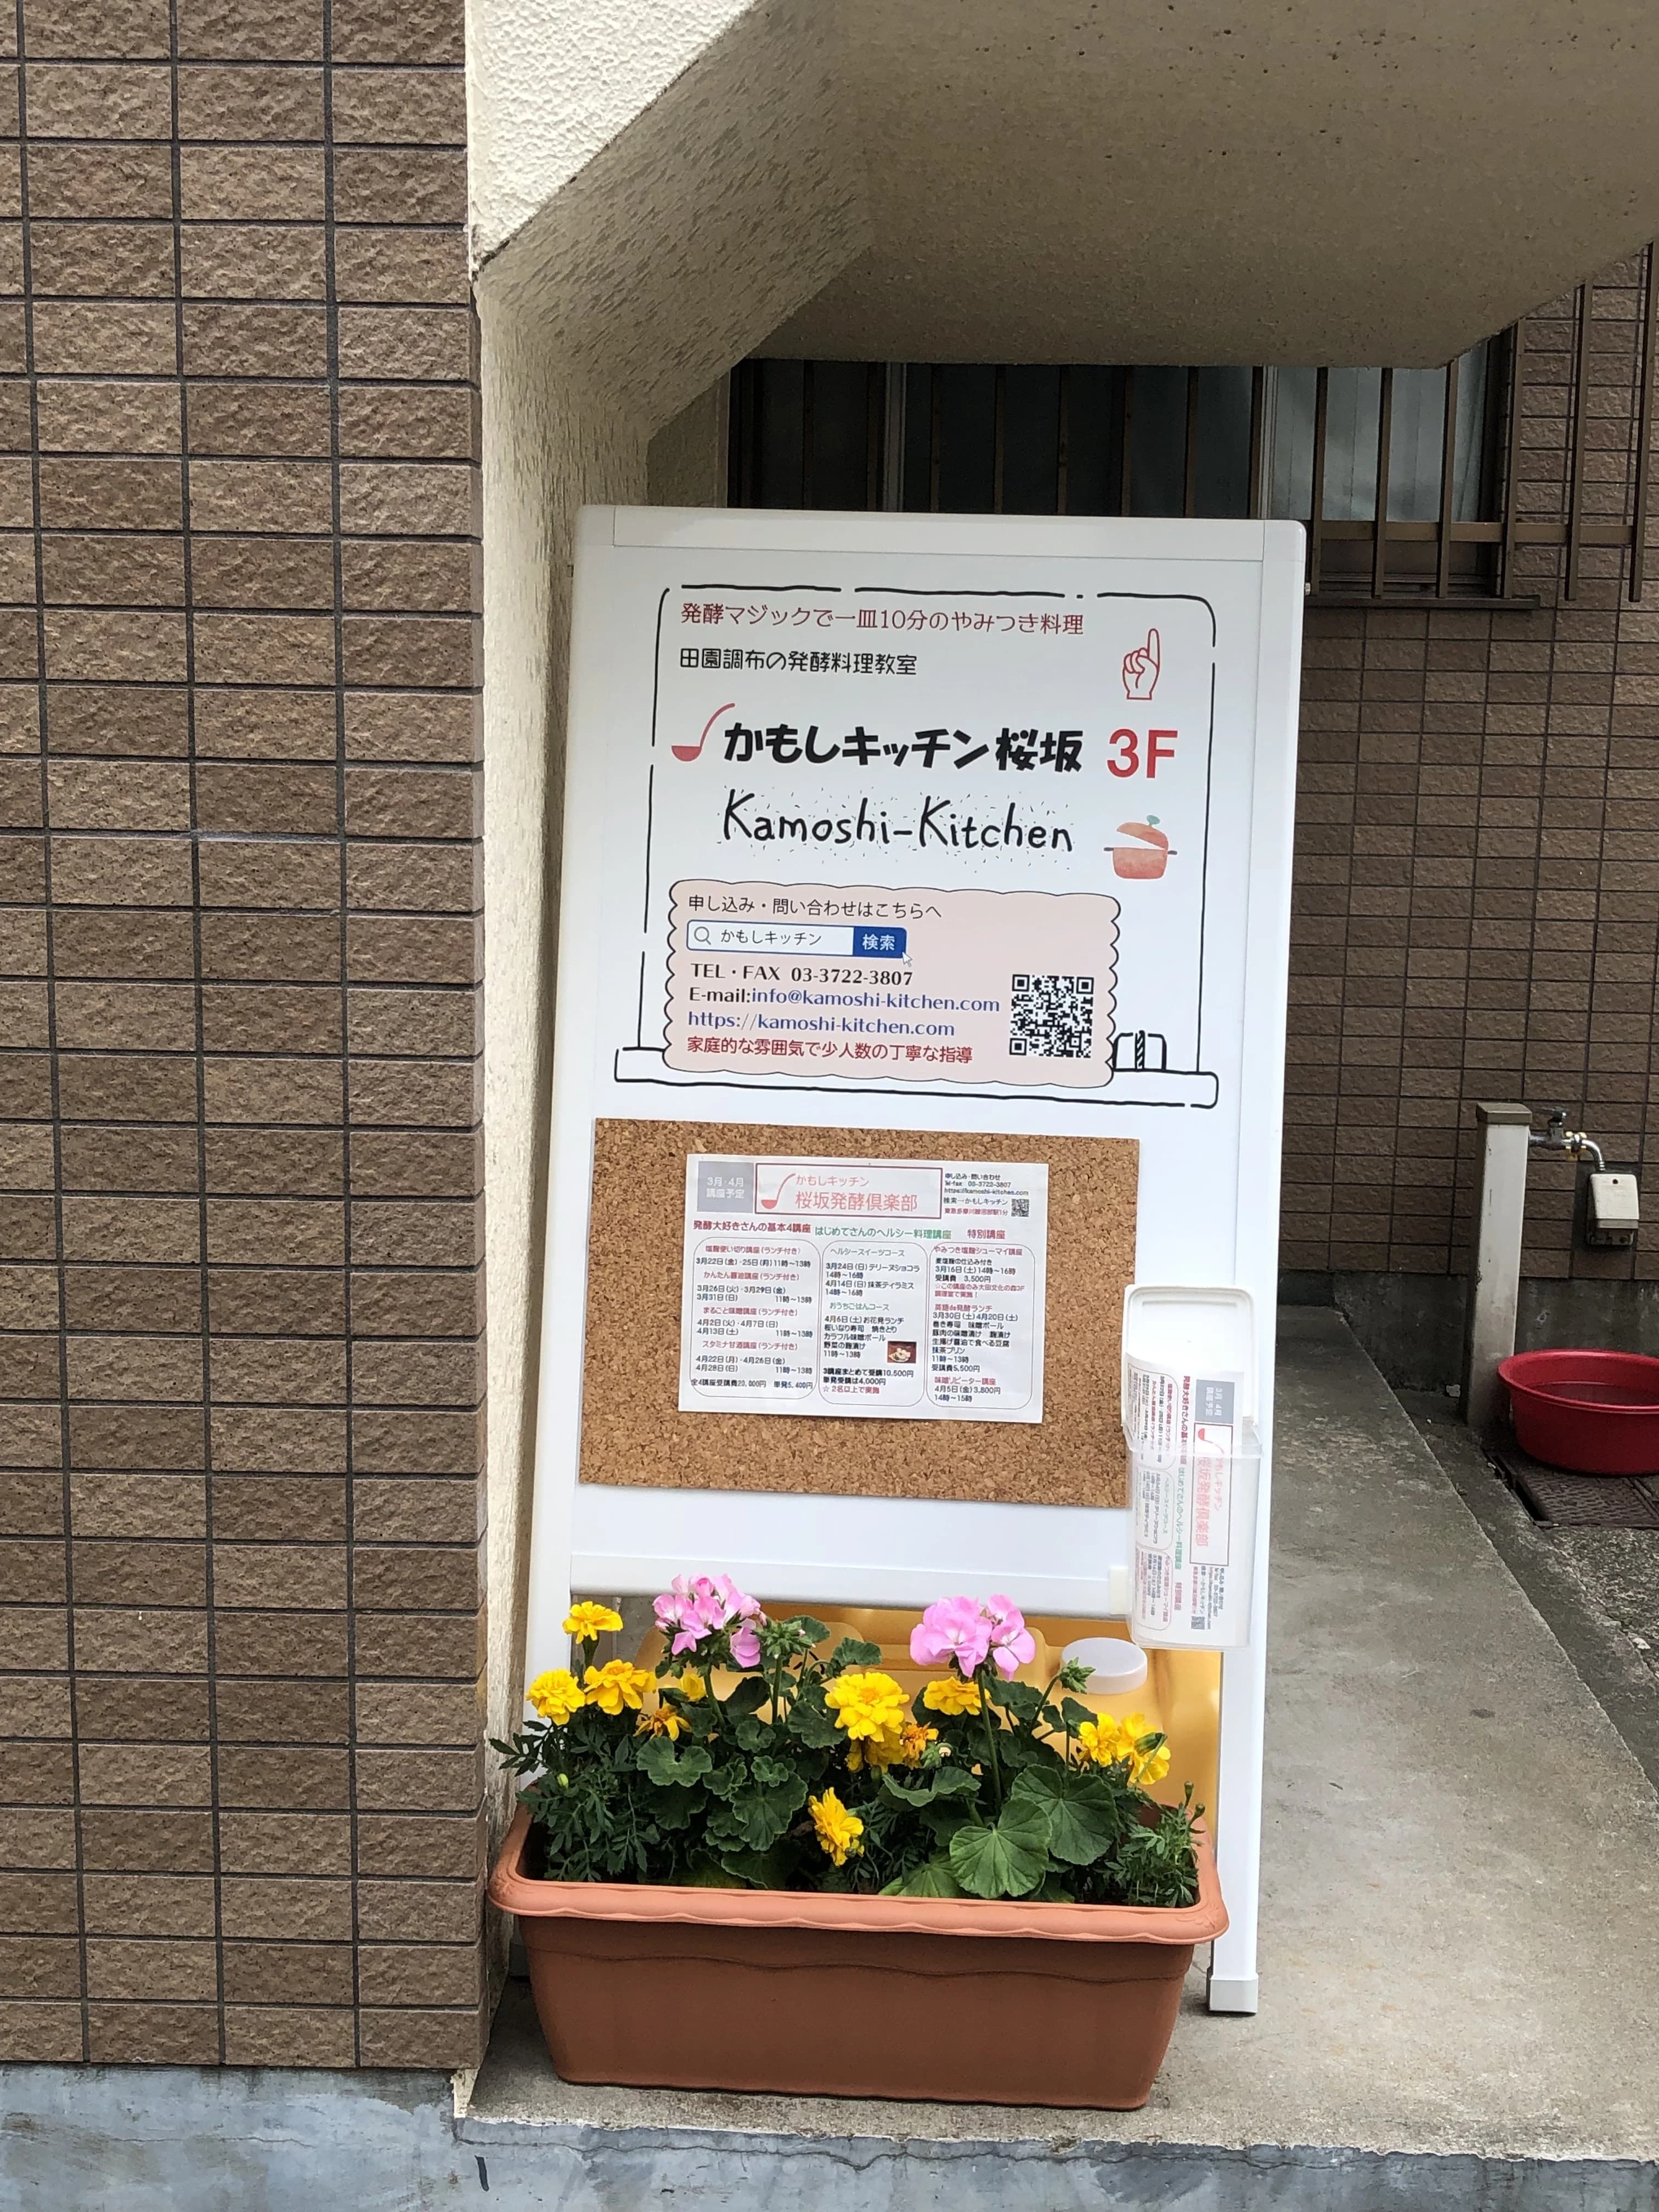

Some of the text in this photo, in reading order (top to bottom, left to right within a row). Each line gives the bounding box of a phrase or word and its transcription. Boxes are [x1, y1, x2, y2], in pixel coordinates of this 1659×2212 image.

[680, 602, 1084, 636] 発酵マジックで一皿10分のやみつき料理
[679, 647, 917, 676] 田園調布の発酵料理教室
[723, 721, 1178, 778] かもしキッチン桜坂 3F
[723, 790, 1073, 852] Kamoshi-Kitchen
[689, 895, 943, 919] 申し込み・問い合わせはこちらへ
[720, 929, 822, 947] かもしキッチン
[862, 933, 896, 952] 検索
[791, 967, 913, 986] 03-3722-3807
[690, 986, 1000, 1013] E-mail:info@kamoshi-kitchen.com
[687, 1011, 956, 1037] https://kamoshi-kitchen.com
[687, 1036, 973, 1064] 家庭的な雰囲気で少人数の丁寧な指導
[795, 1175, 870, 1187] かもしキッチン
[706, 1188, 744, 1199] 講座予定
[795, 1190, 918, 1212] 桜坂発酵倶楽部
[693, 1220, 811, 1233] 発酵大好きさんの基本4講座
[815, 1226, 952, 1240] はじめてさんのヘルシー料理講座
[967, 1229, 1006, 1239] 特別講座
[830, 1248, 905, 1257] ヘルシースイーツコース
[830, 1302, 889, 1311] おうちごはんコース
[823, 1333, 886, 1342] カラフル味噌ボール
[934, 1376, 996, 1386] 味噌リピーター講座
